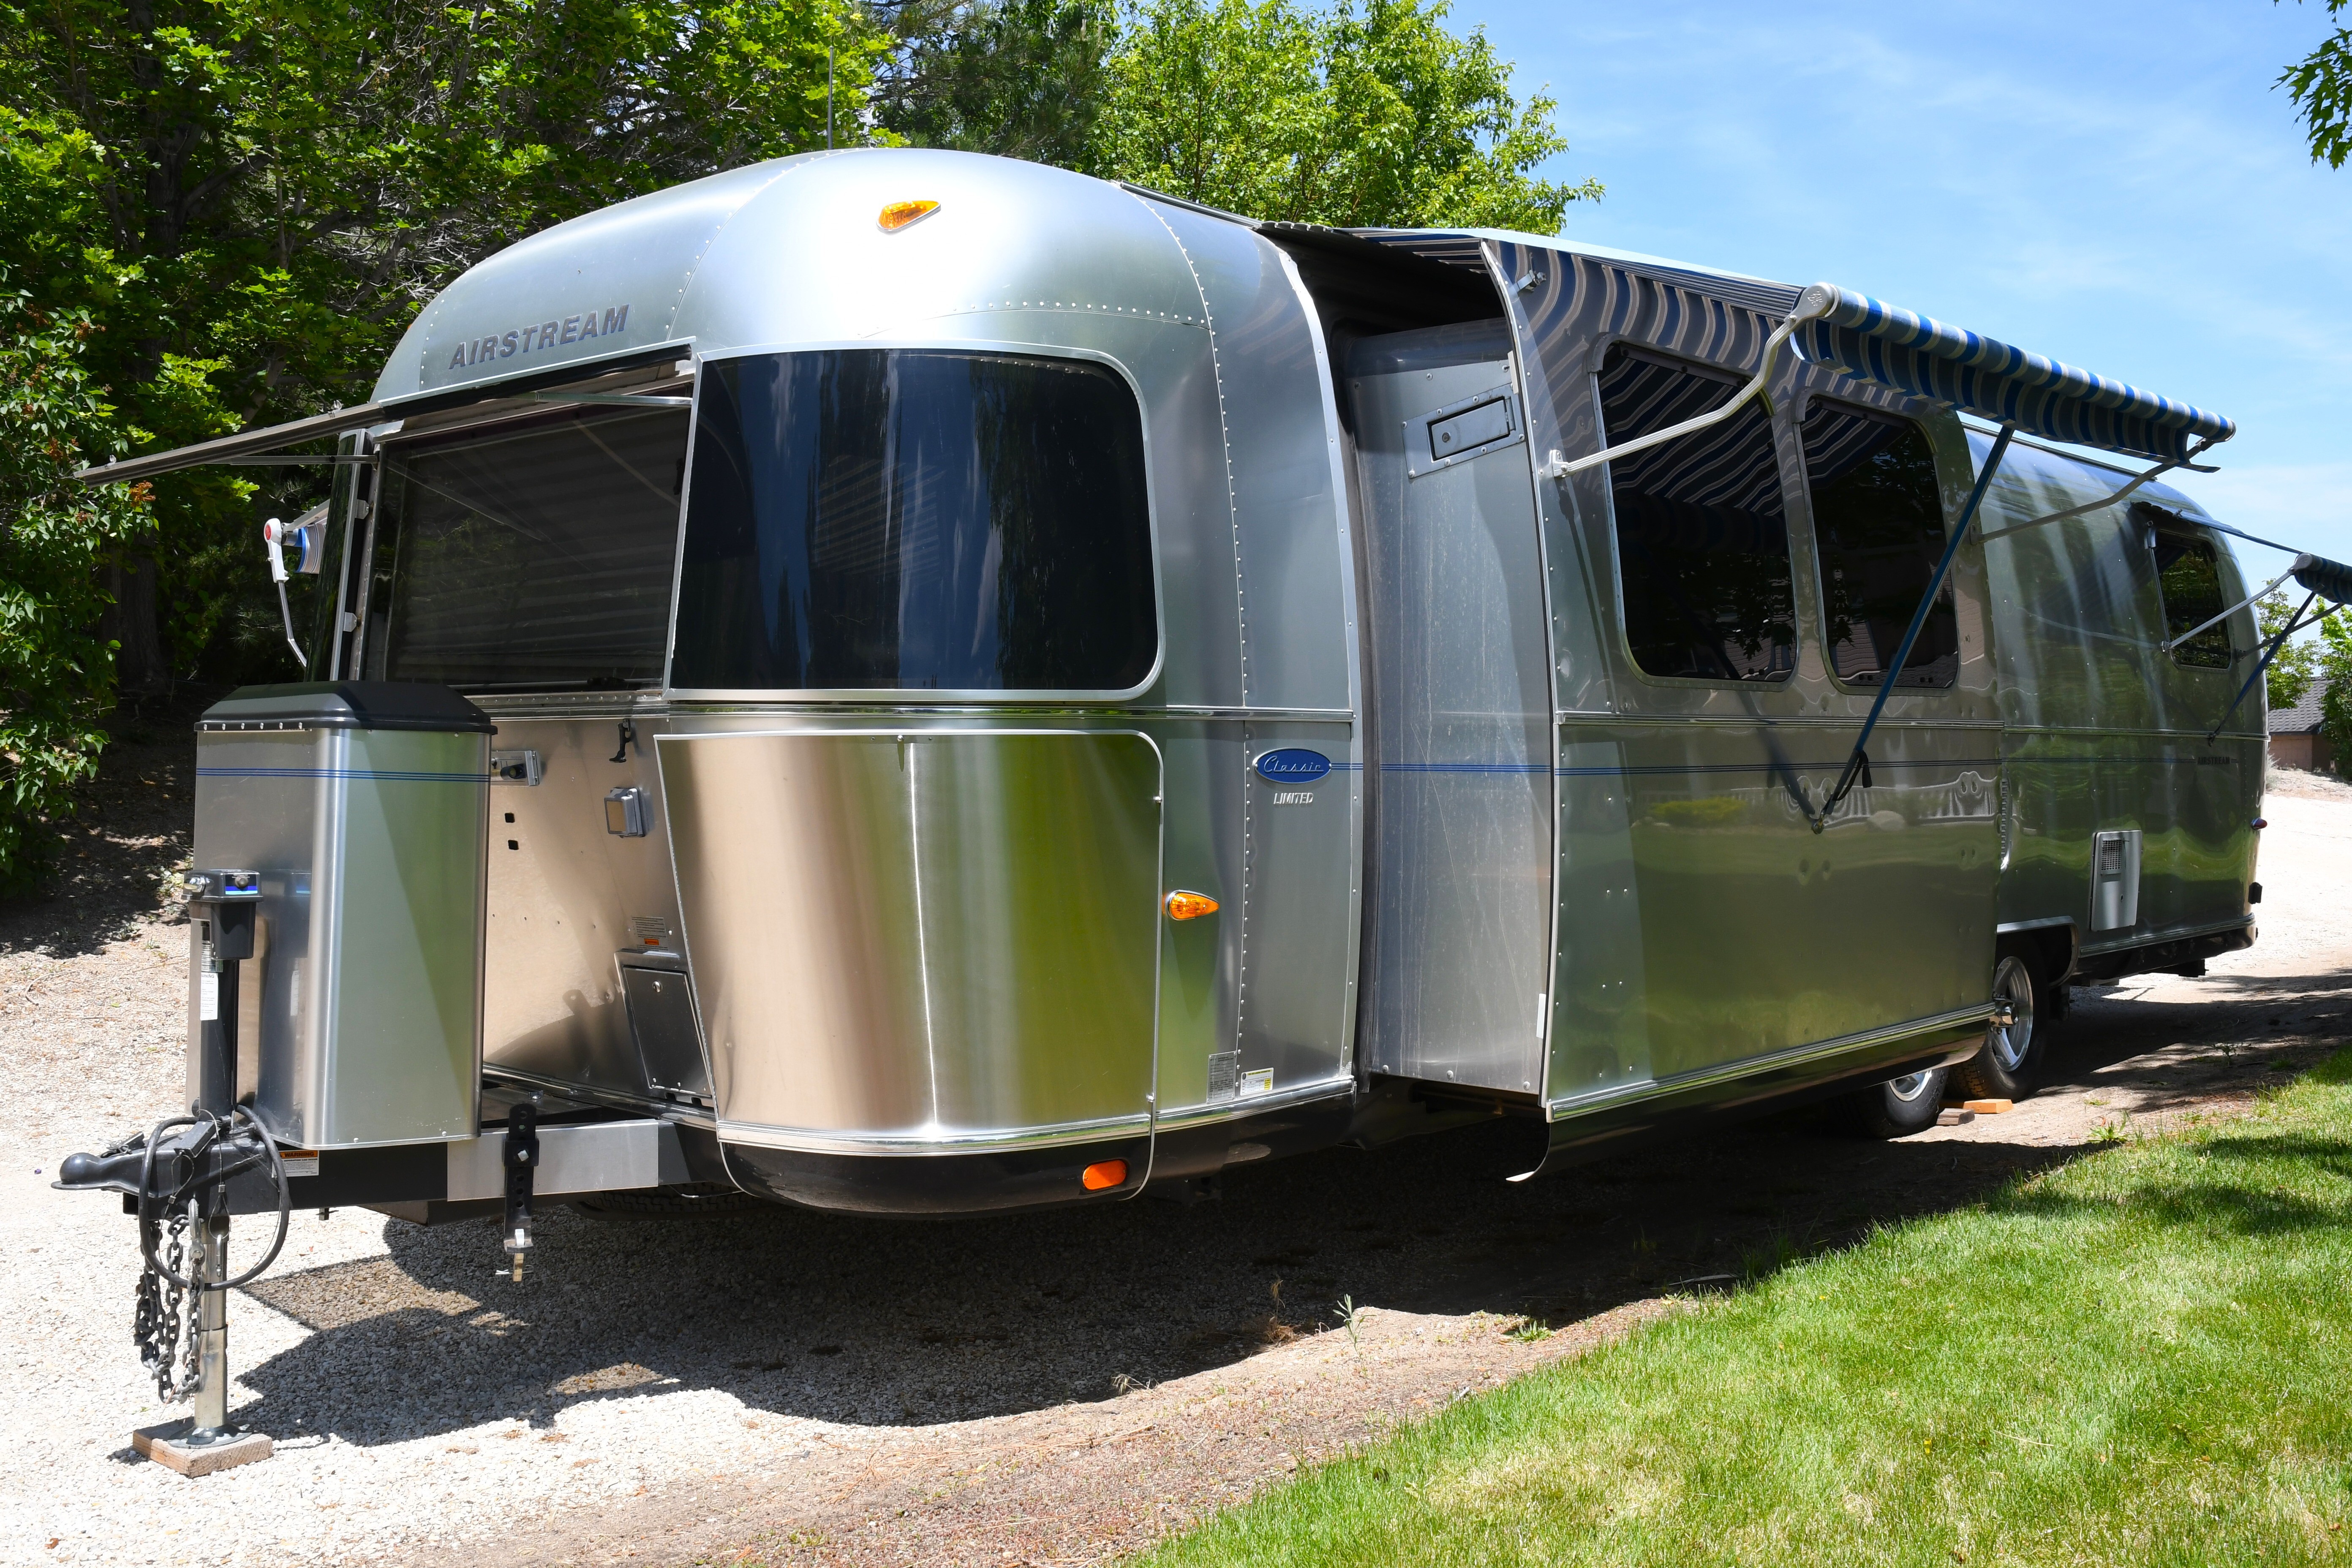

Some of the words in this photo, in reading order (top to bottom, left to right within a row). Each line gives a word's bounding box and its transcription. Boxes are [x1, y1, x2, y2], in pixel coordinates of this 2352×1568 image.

[449, 304, 630, 370] AIRSTREAM
[1264, 755, 1324, 773] Classic
[2197, 757, 2230, 765] AIRSTREAM
[1273, 792, 1314, 804] LIMITED
